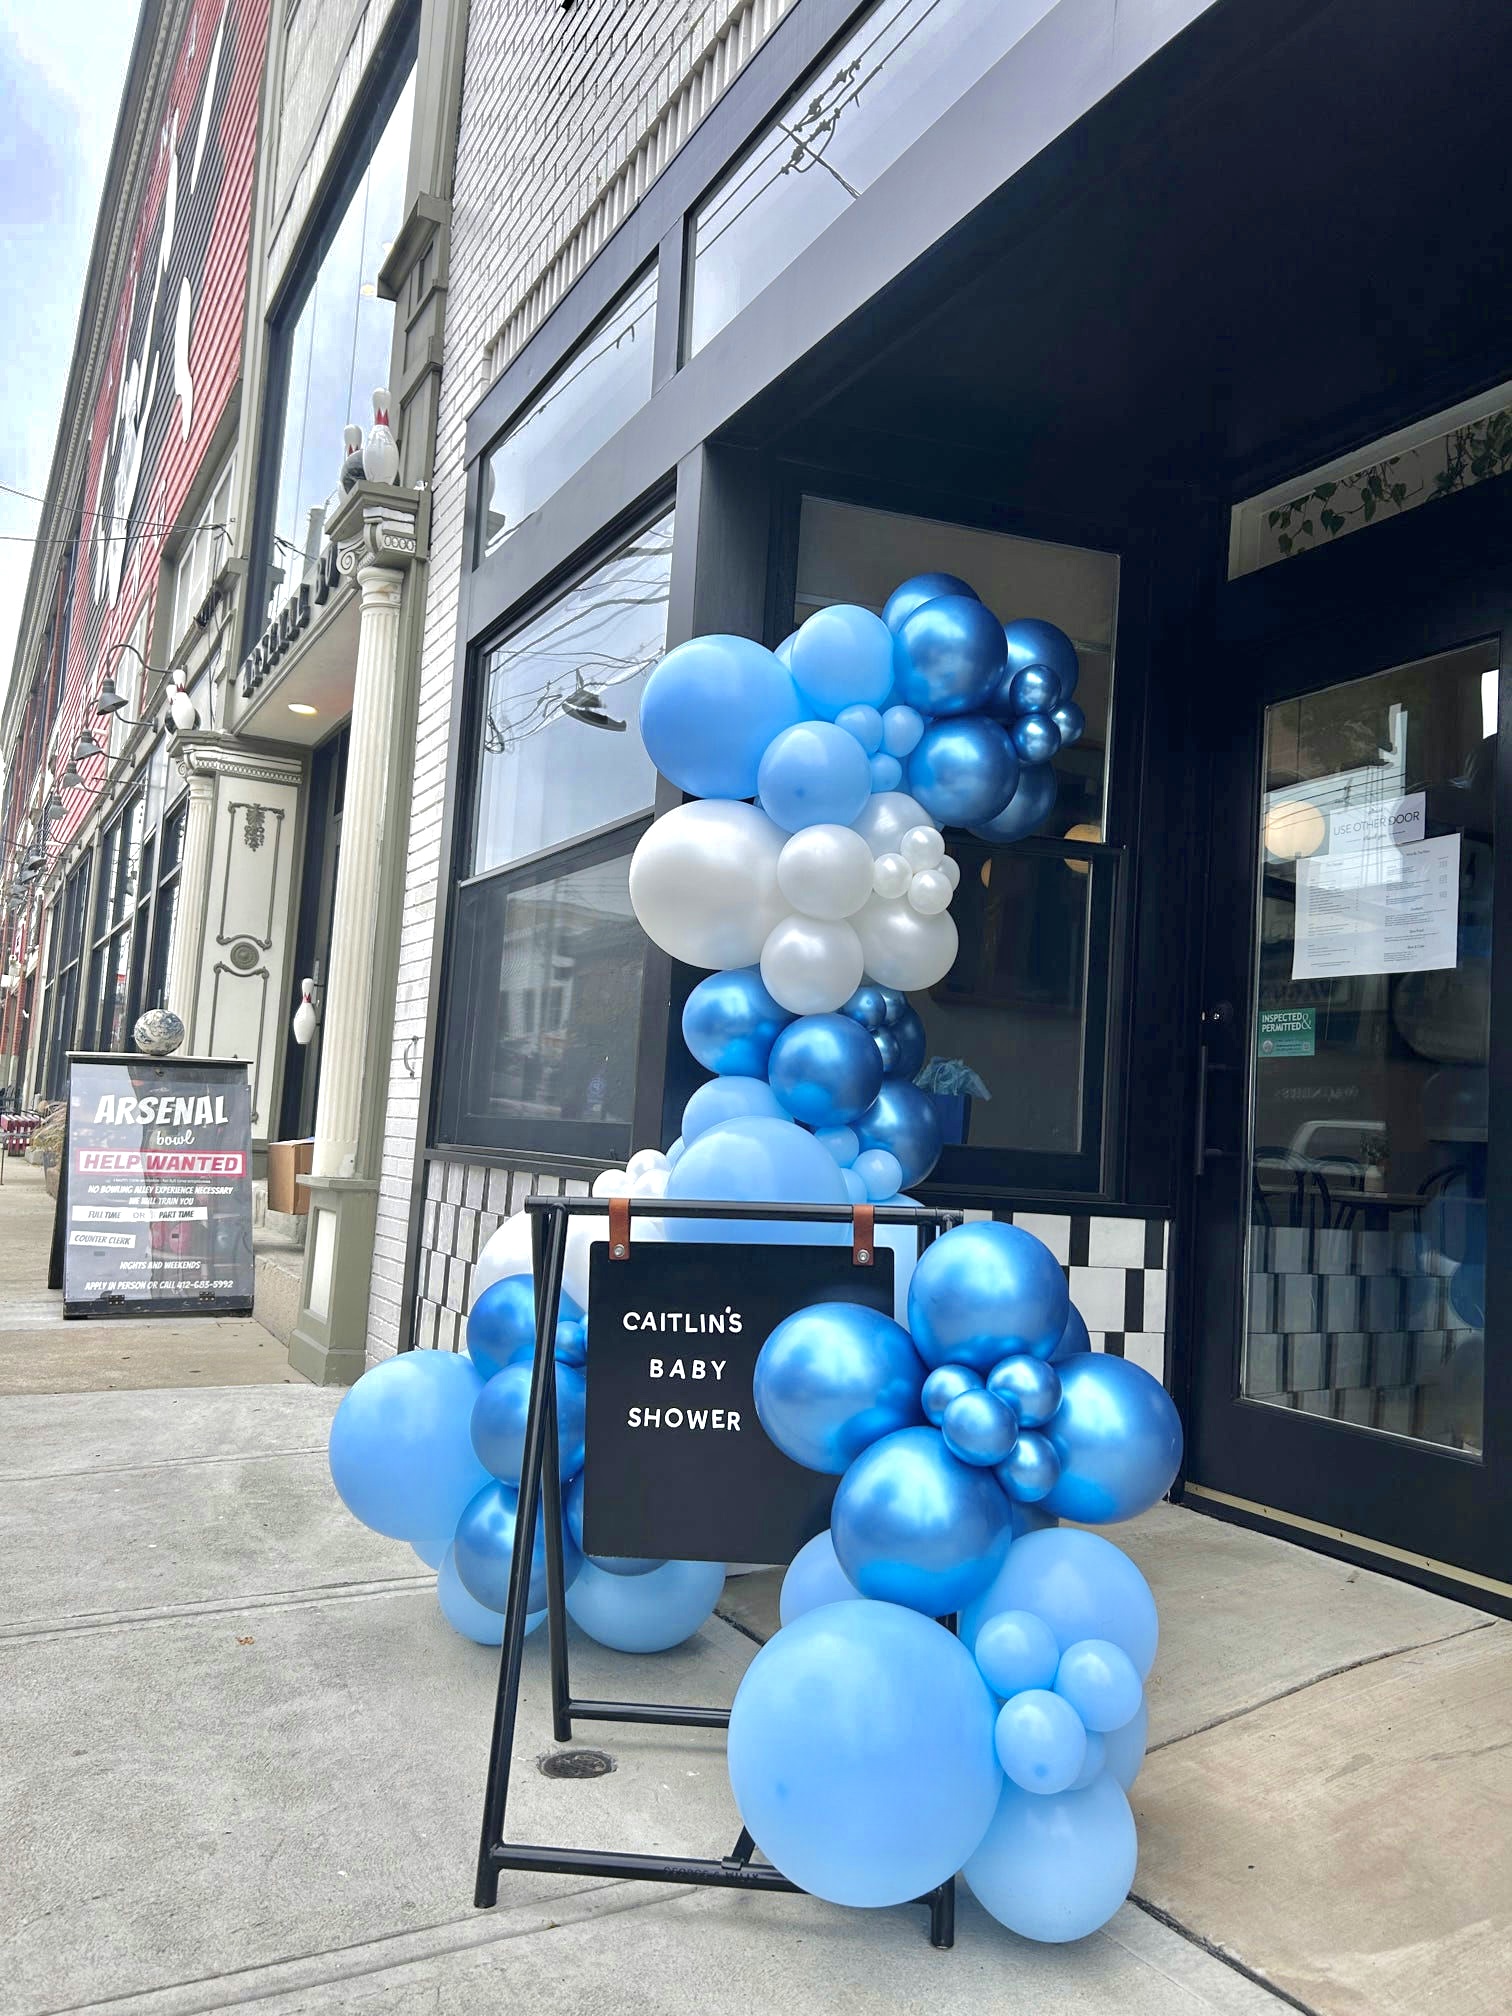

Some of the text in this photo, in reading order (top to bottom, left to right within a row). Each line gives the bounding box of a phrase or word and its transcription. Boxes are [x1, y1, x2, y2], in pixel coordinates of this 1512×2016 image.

[1333, 811, 1420, 836] USE OTHER DOOR
[1262, 1012, 1312, 1030] INSPECTED &
[1262, 1022, 1301, 1032] PERMITTED
[94, 1094, 228, 1126] ARSENAL
[156, 1129, 195, 1146] bowl
[84, 1154, 239, 1171] HELP WANTED
[88, 1185, 234, 1195] NO BOWLING ALLEY EXPERIENCE NECESSARY
[158, 1197, 179, 1205] TRAIN
[179, 1197, 195, 1206] YOU
[87, 1210, 195, 1219] FULL TIME OR PART TIME
[74, 1234, 132, 1246] COUNTER CLERK
[120, 1261, 201, 1270] NIGHTS AND WEEKENDS
[84, 1281, 108, 1290] APPLY
[107, 1281, 117, 1290] IN
[117, 1281, 147, 1290] PERSON
[147, 1280, 159, 1289] OR
[159, 1280, 176, 1289] CALL
[622, 1306, 743, 1333] CAITLIN'S
[649, 1358, 727, 1380] BABY
[627, 1407, 741, 1431] SHOWER
